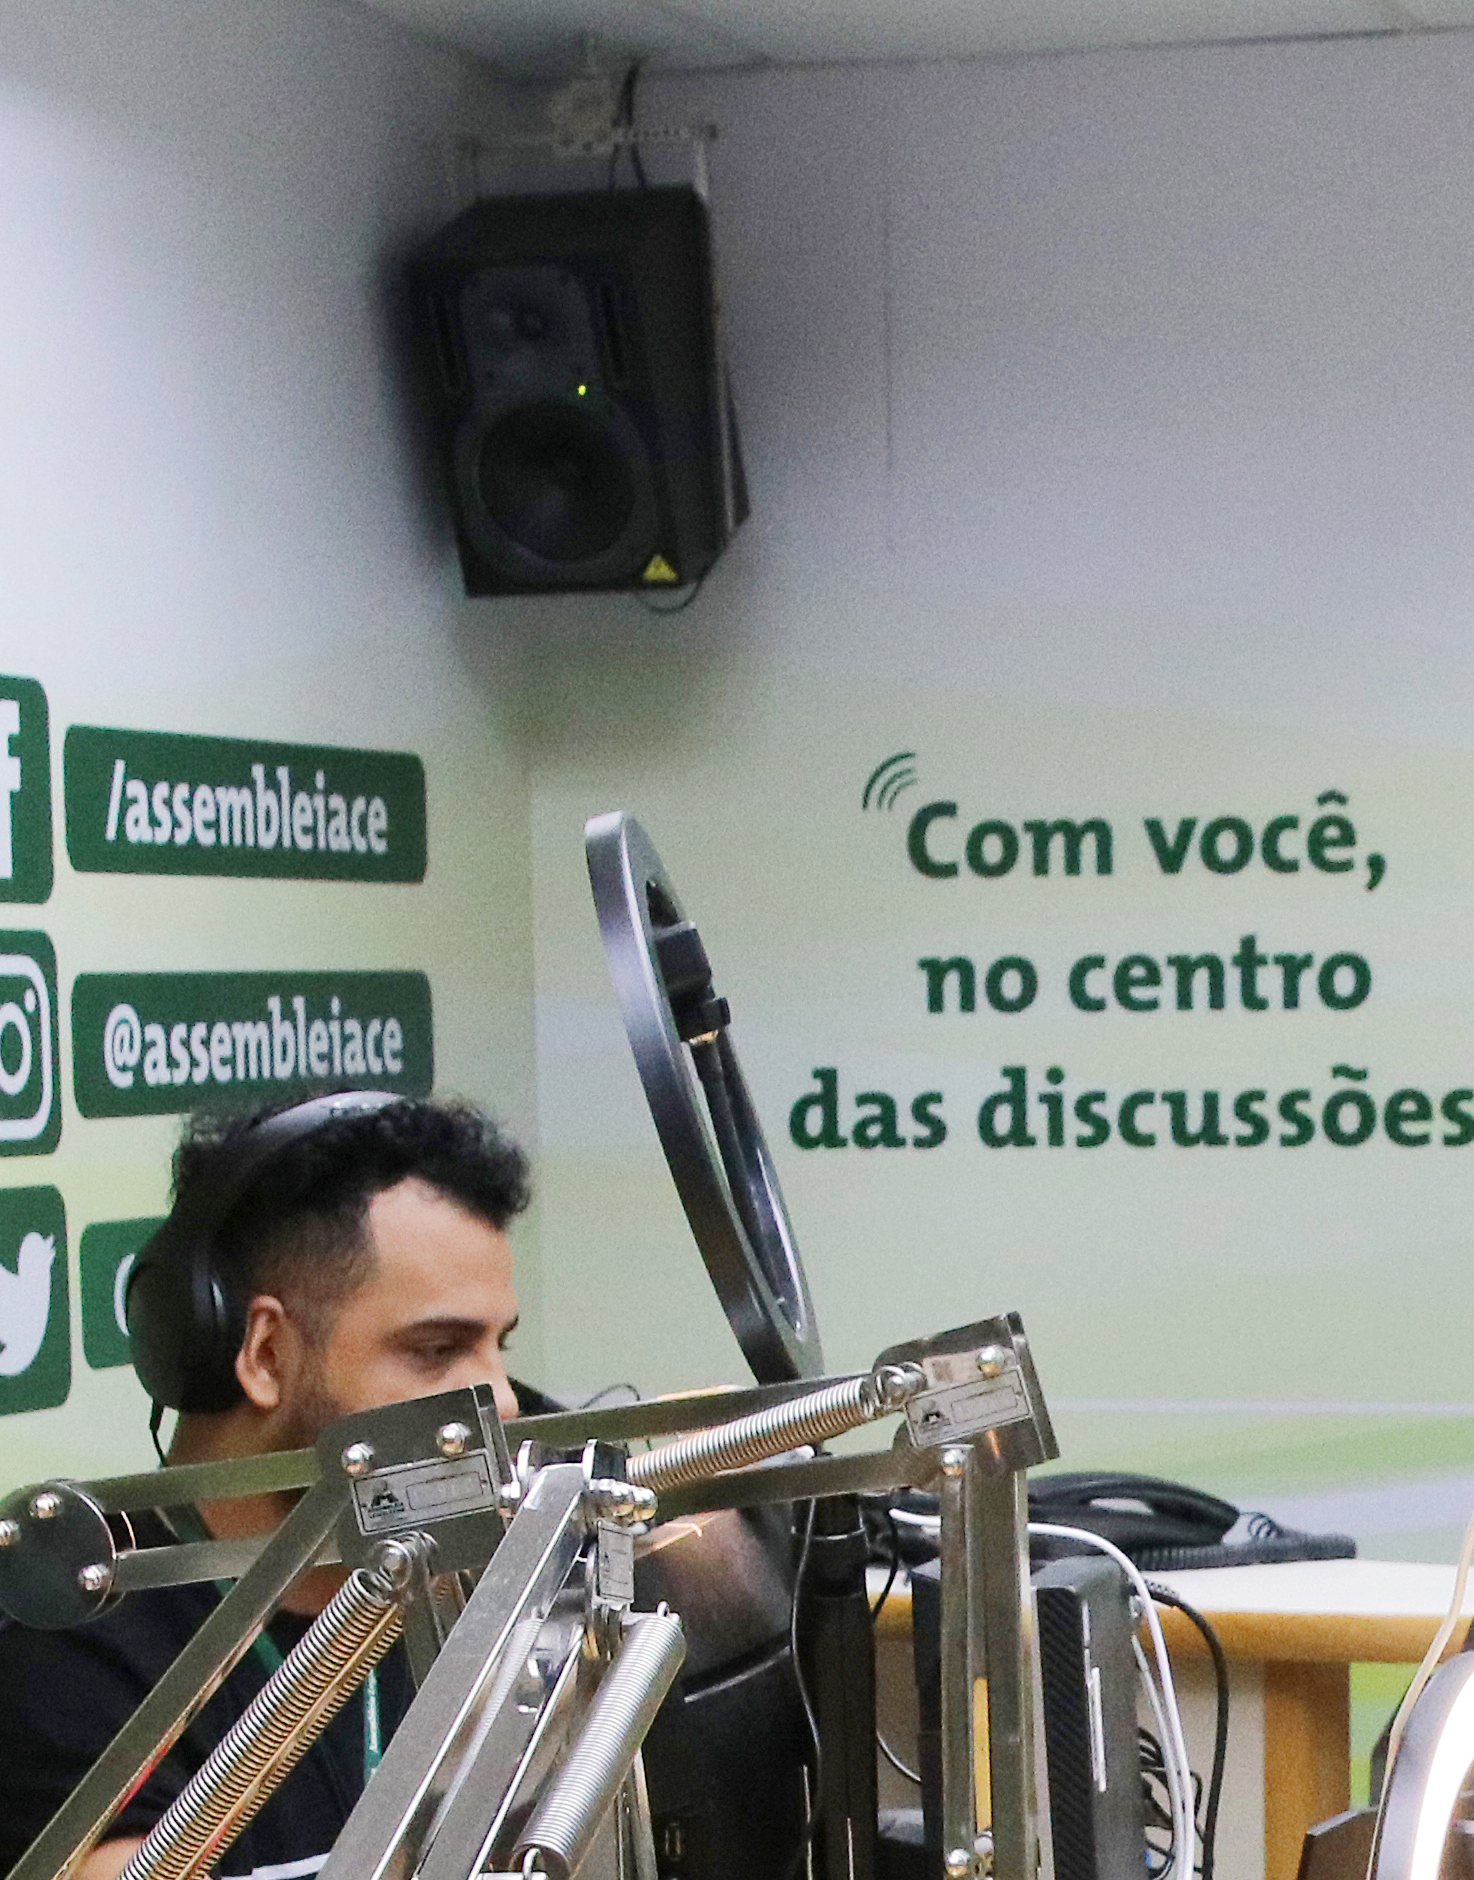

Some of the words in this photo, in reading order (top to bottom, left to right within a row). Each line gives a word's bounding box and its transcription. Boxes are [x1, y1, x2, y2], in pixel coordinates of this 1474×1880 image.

[105, 758, 390, 854] /assembleiace
[906, 800, 1113, 879] Com
[1143, 789, 1388, 892] você,
[918, 953, 1039, 1014] no
[1068, 934, 1372, 1013] centro
[103, 995, 403, 1089] @assembleiace
[788, 1068, 948, 1150] das
